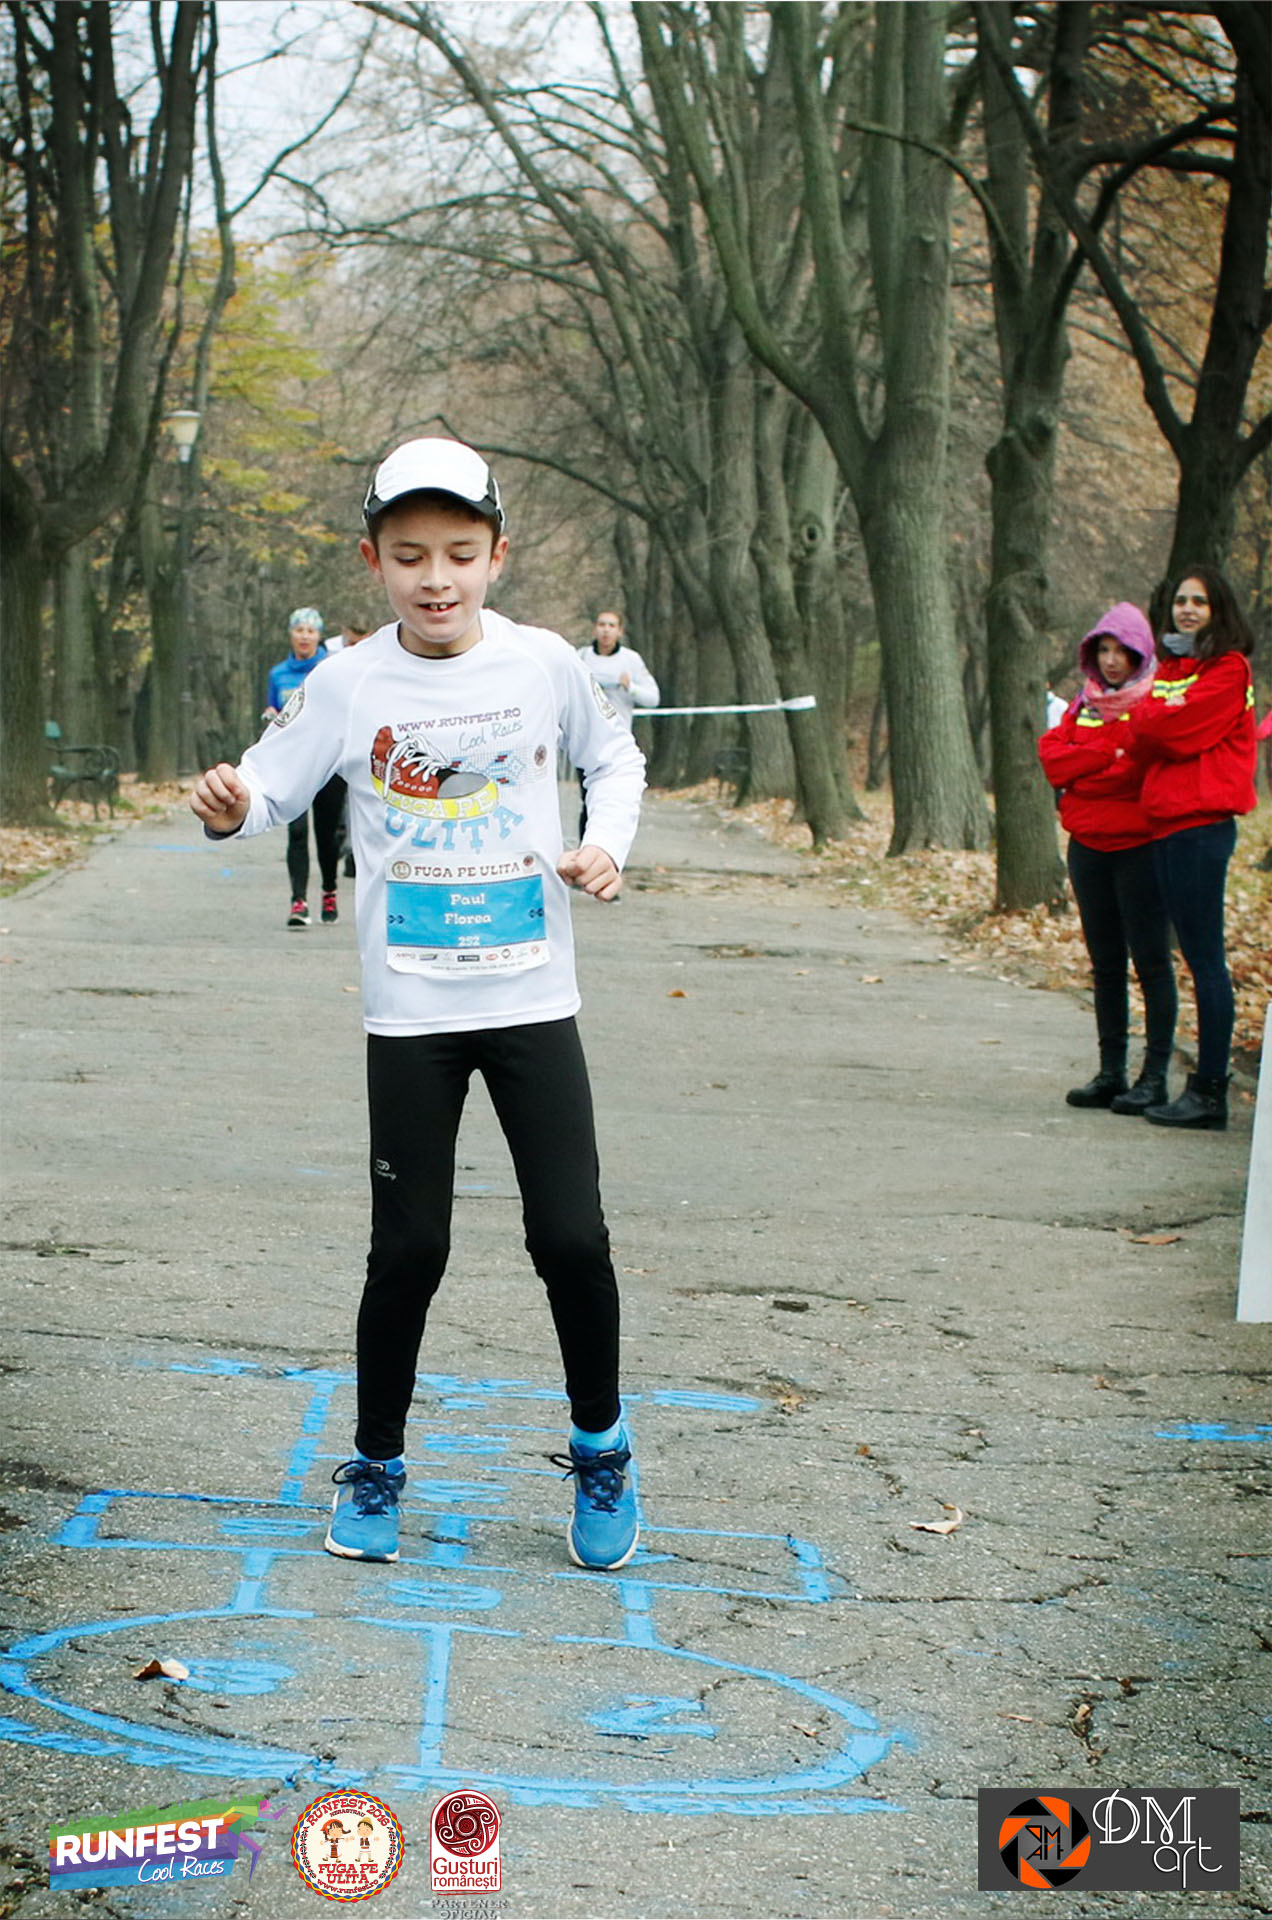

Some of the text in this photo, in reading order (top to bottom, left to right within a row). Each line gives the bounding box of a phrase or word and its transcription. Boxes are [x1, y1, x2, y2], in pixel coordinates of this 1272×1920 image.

[397, 707, 521, 732] WWW.RUNFEST.RO
[459, 728, 487, 751] Cool
[385, 806, 524, 850] ULITA
[414, 862, 520, 878] FUGA PE ULITA
[450, 893, 486, 906] Paul
[444, 913, 492, 925] Florea
